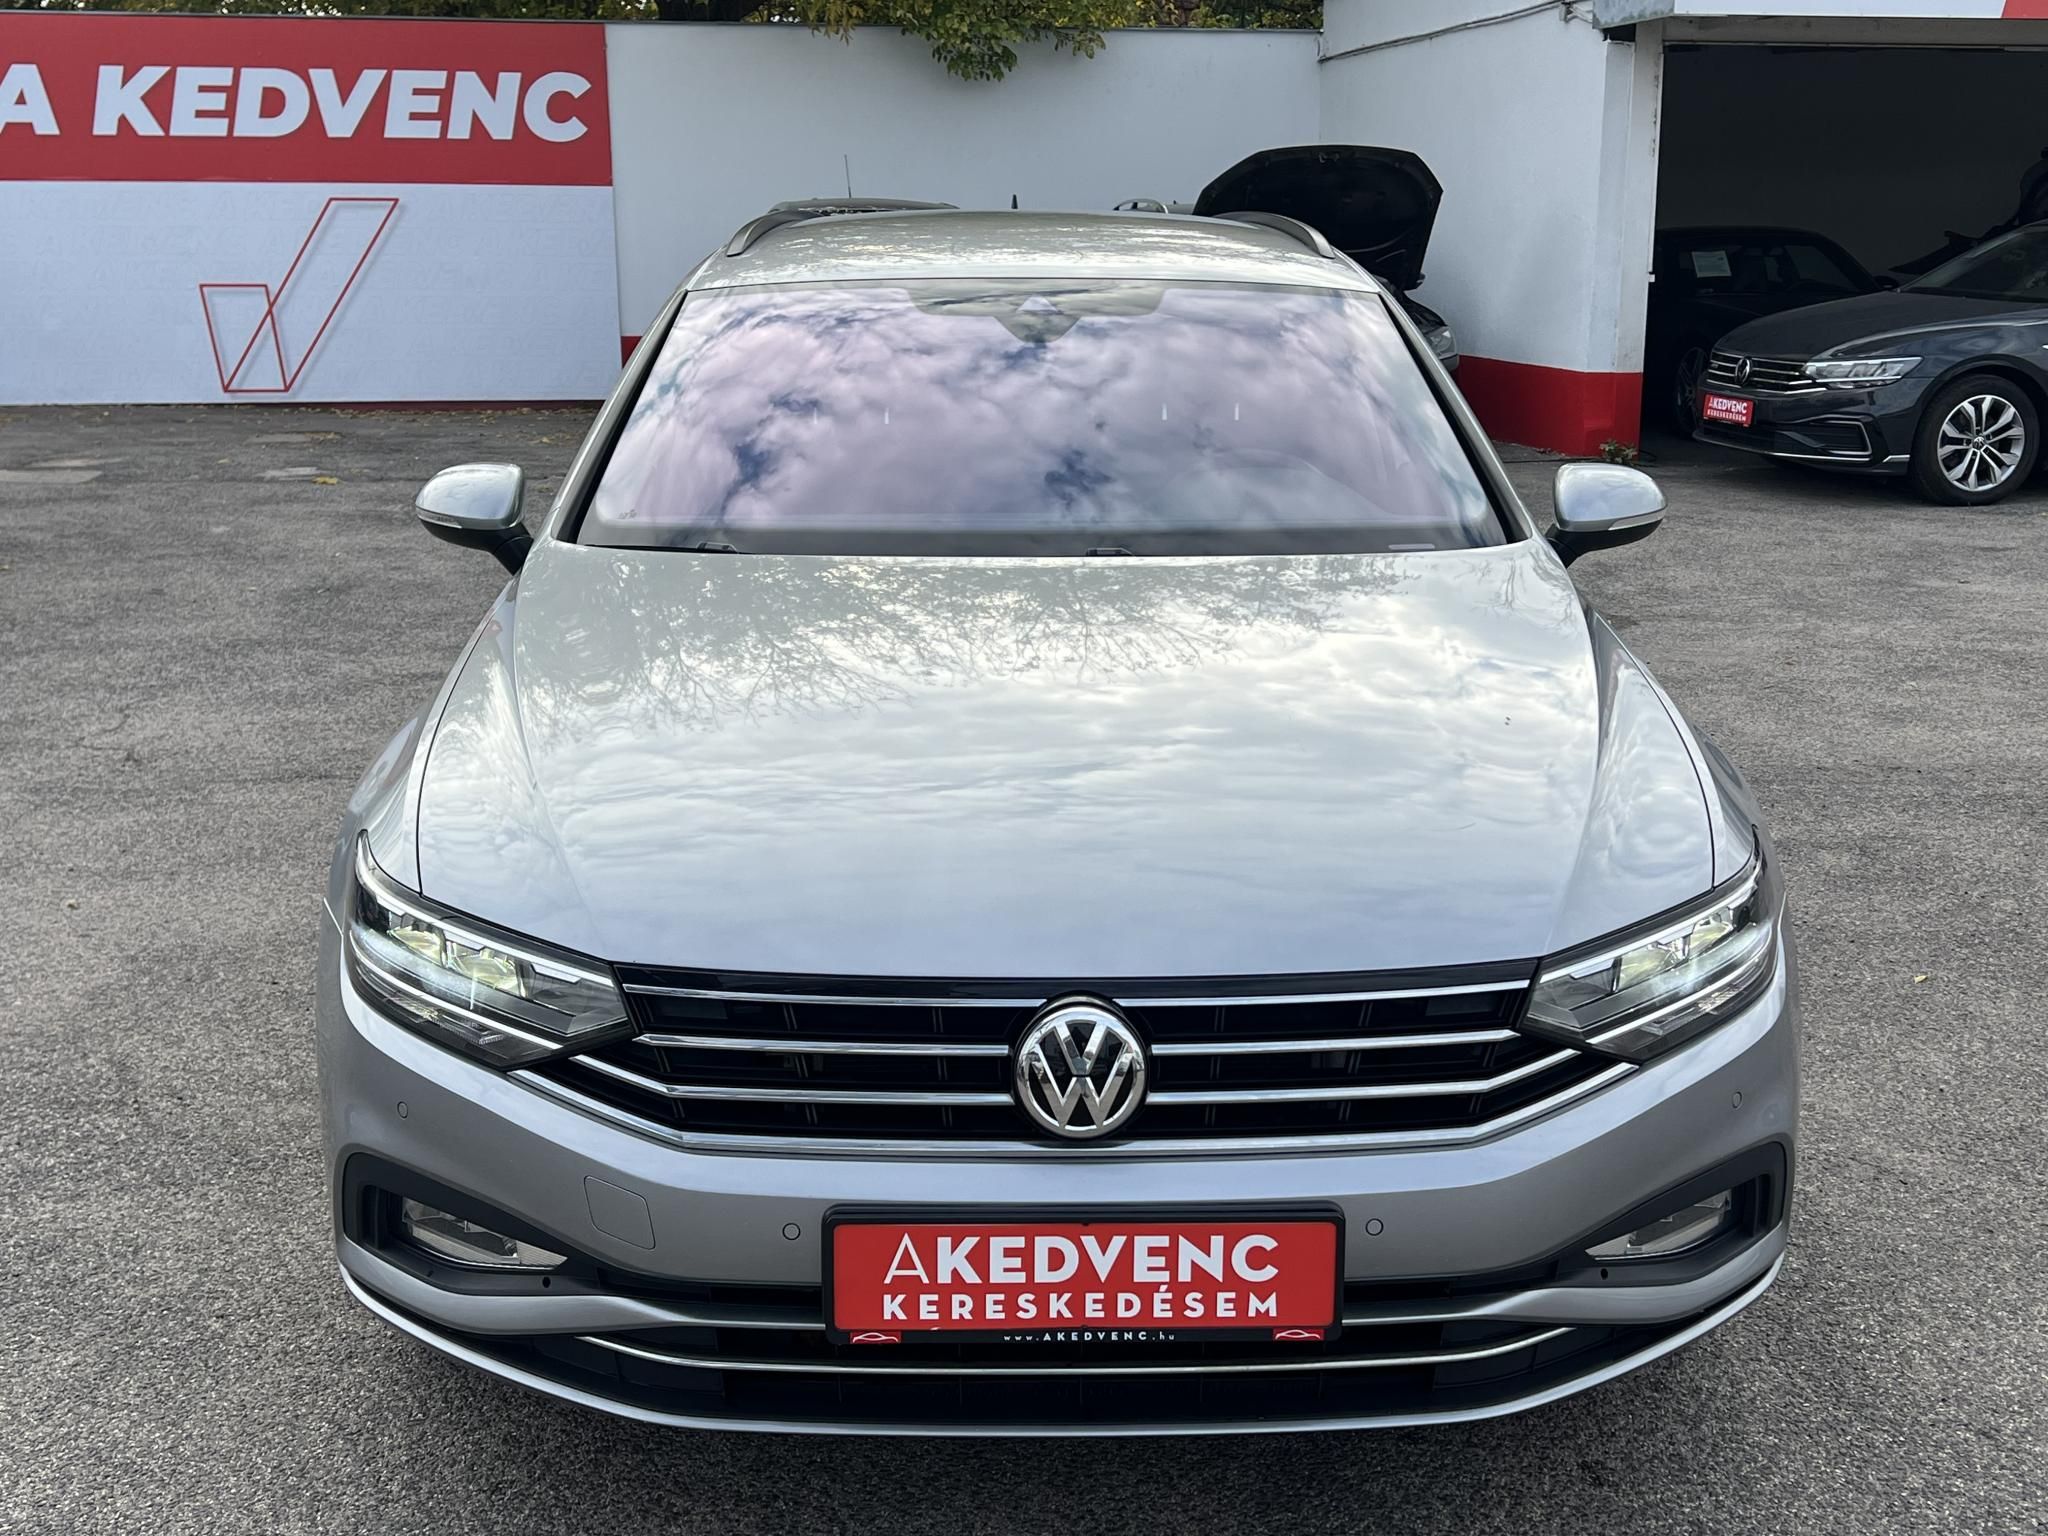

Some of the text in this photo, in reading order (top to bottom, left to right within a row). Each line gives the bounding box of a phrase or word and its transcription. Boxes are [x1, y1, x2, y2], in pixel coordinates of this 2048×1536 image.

[0, 63, 592, 143] A KEDVENC
[883, 1284, 1277, 1320] KERESKEDÉSEM
[1003, 1330, 1175, 1342] www.AKEDVENC.hu
